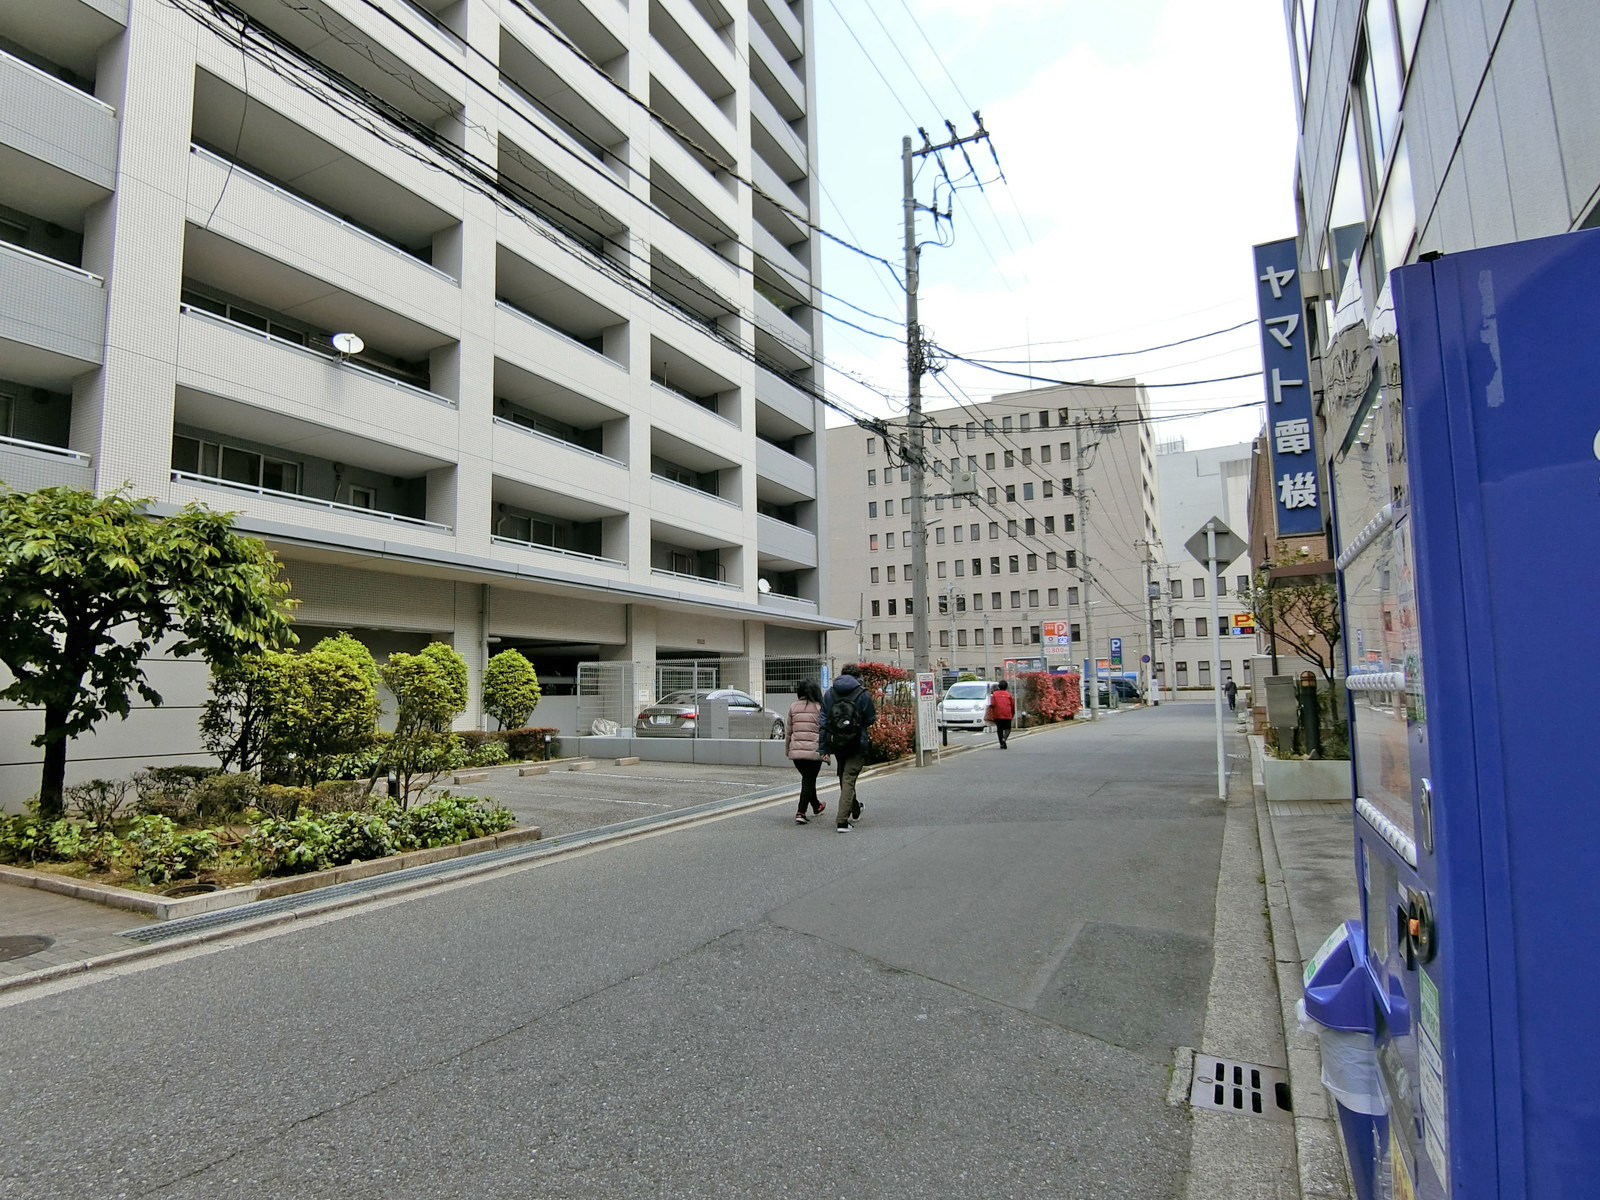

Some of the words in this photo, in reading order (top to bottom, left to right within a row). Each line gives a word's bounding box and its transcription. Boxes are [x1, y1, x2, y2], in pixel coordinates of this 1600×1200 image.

[1260, 265, 1317, 510] ヤマト電機
[1112, 640, 1120, 651] P
